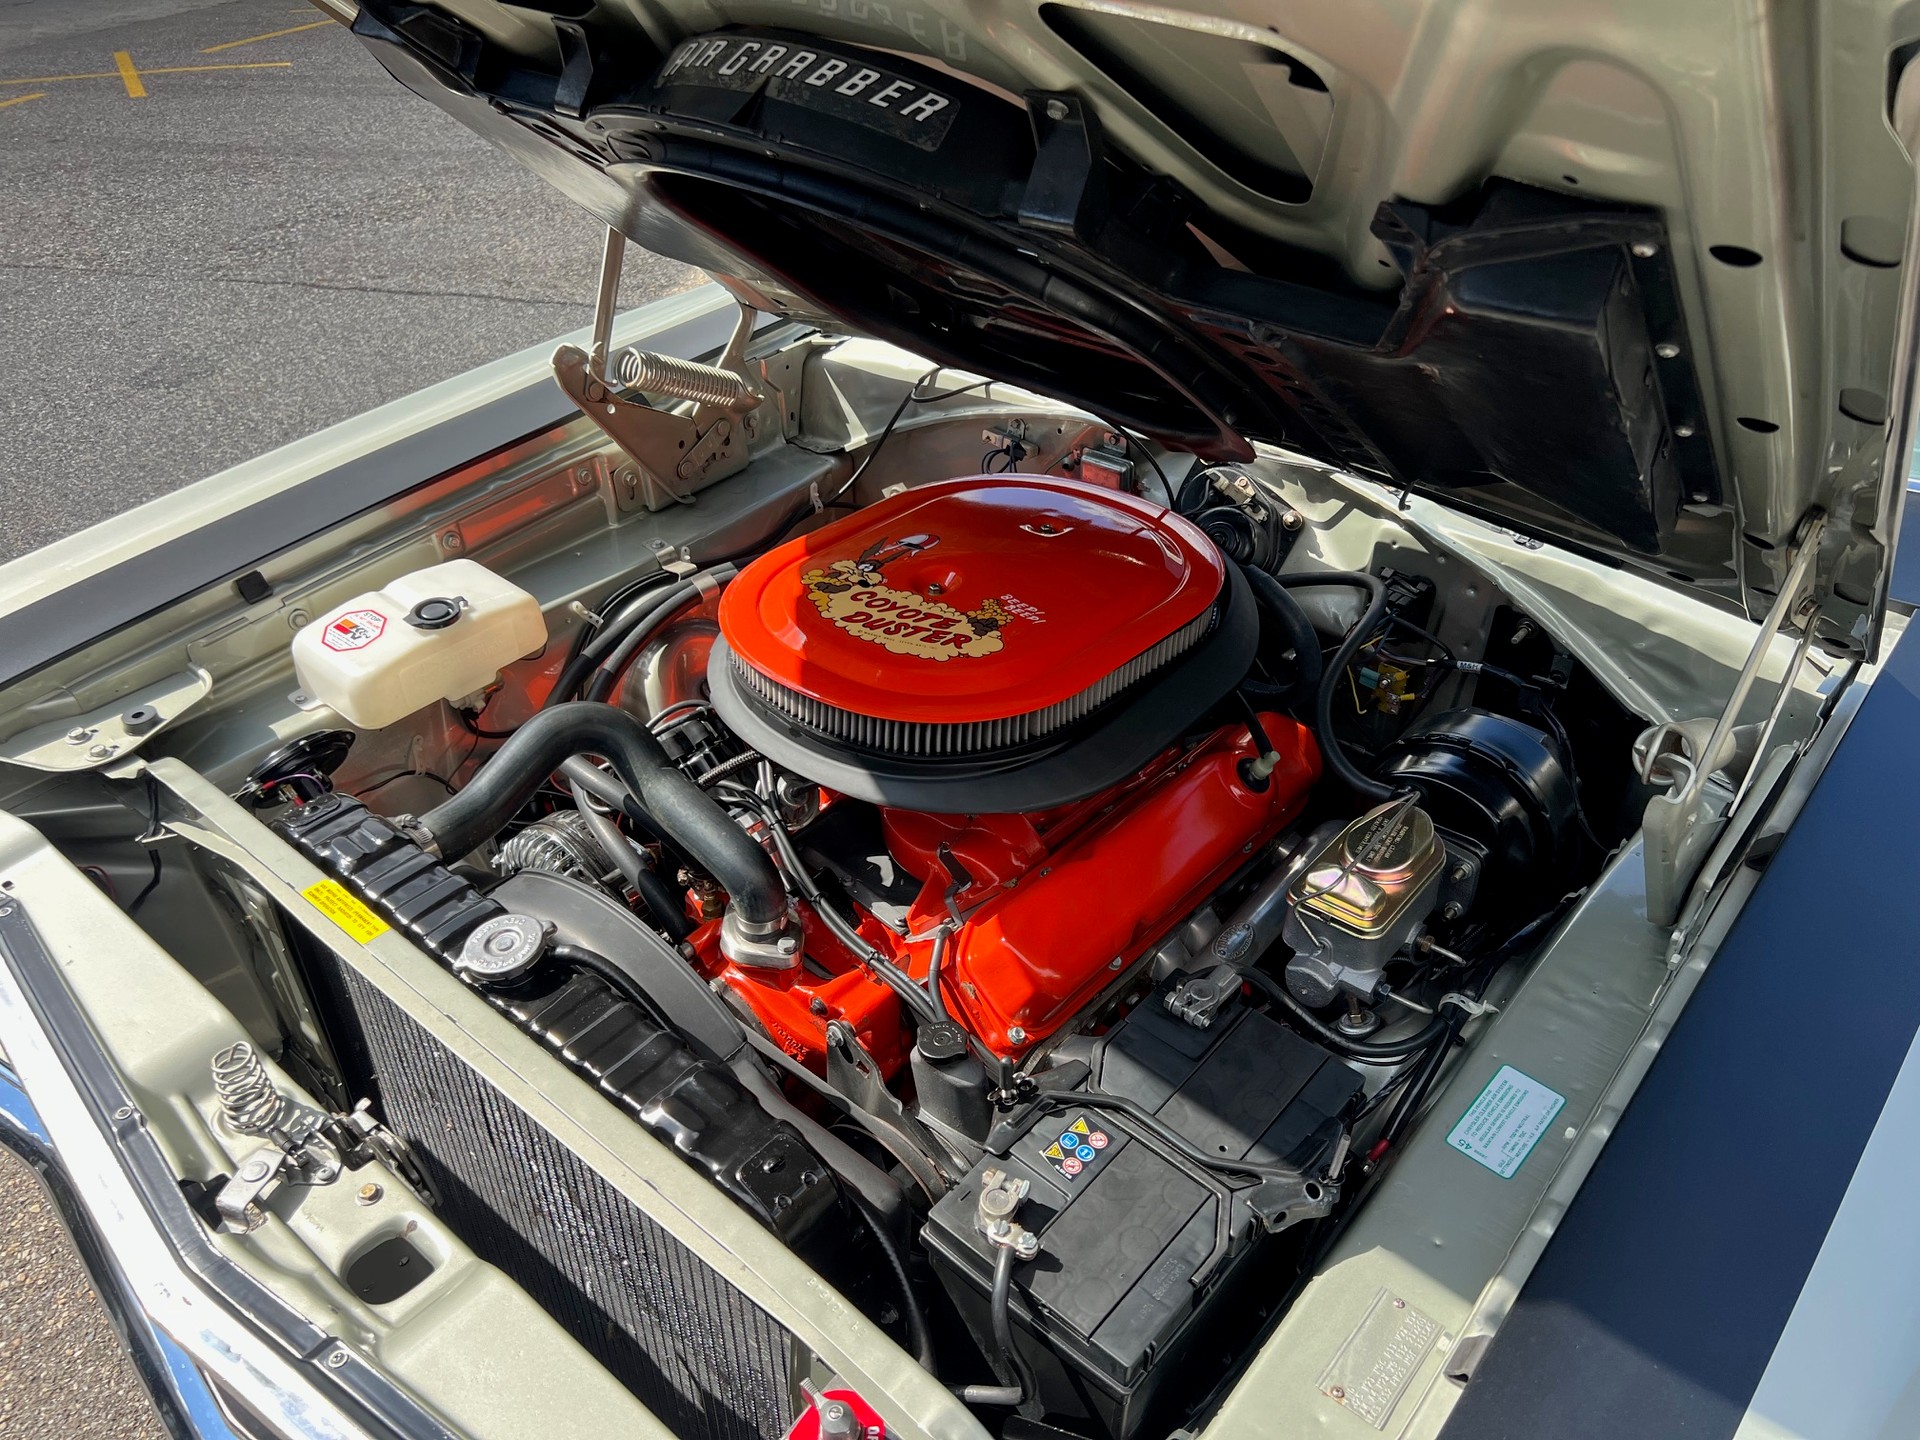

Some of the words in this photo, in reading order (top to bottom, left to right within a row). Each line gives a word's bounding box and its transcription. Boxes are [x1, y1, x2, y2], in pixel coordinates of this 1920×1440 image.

[663, 39, 729, 77] AIR
[718, 41, 952, 123] GRABBER
[850, 590, 963, 631] COYOTE
[1001, 594, 1045, 614] BEEP!
[1004, 605, 1046, 624] BEEP!
[840, 611, 974, 650] DUSTER
[1463, 1116, 1480, 1135] CHRYSLER
[1477, 1099, 1493, 1117] CLEANER
[1495, 1079, 1508, 1093] SYSTEM
[1486, 1102, 1499, 1117] VEHICLE
[1457, 1138, 1472, 1150] 45
